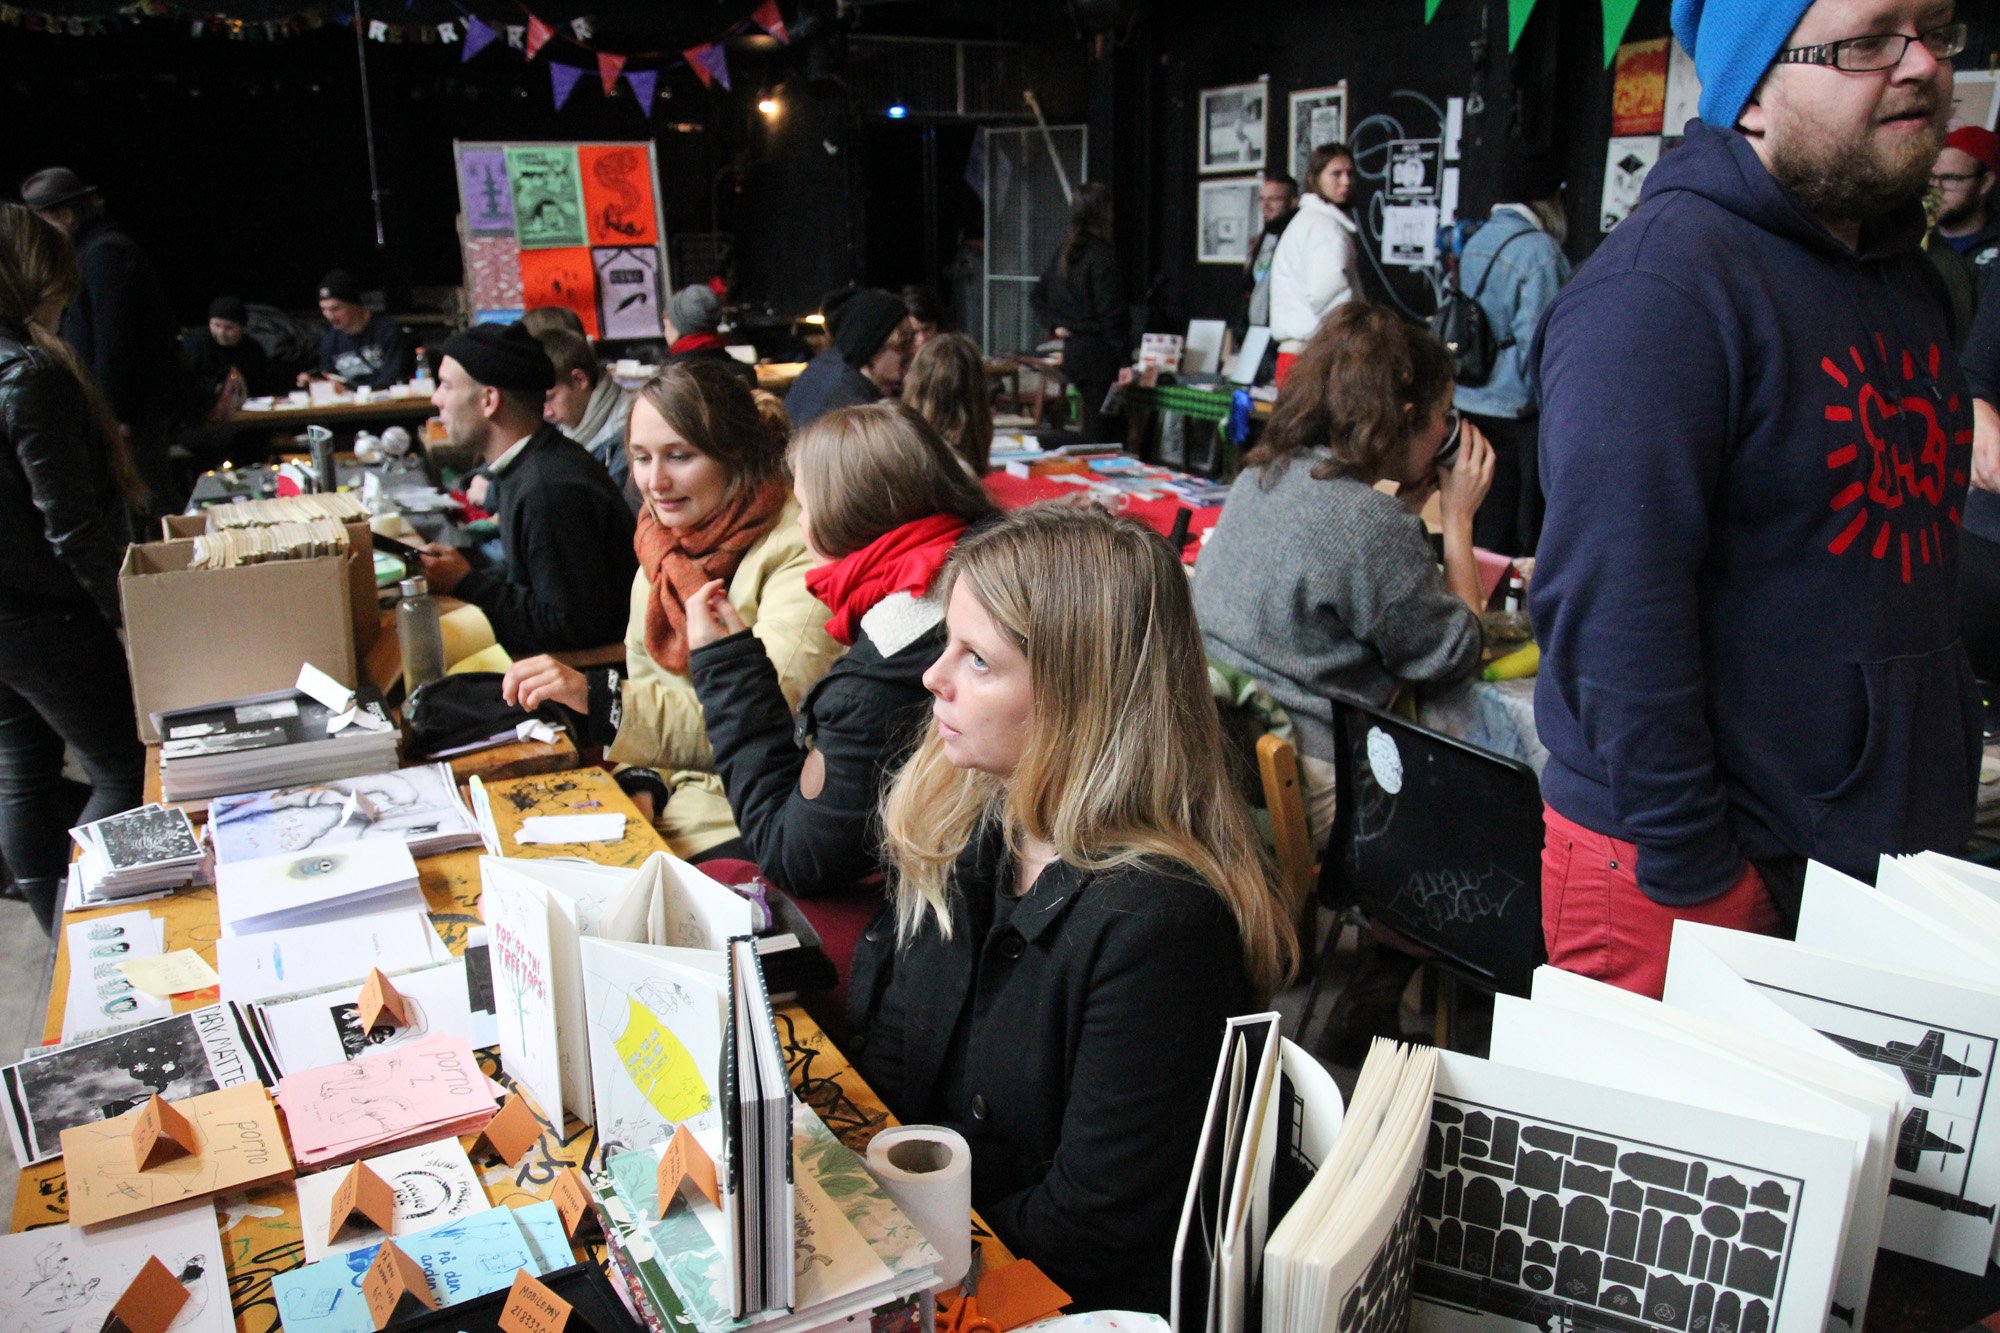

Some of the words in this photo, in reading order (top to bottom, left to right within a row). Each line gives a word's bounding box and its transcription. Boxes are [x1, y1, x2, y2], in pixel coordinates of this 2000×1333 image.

[495, 922, 511, 946] TOP
[192, 1004, 227, 1038] DARK
[419, 1050, 473, 1095] porno
[216, 1119, 269, 1165] porno
[420, 1254, 441, 1291] anden
[437, 1250, 457, 1266] på
[444, 1270, 463, 1295] den
[518, 1285, 561, 1323] MOBILEPAY
